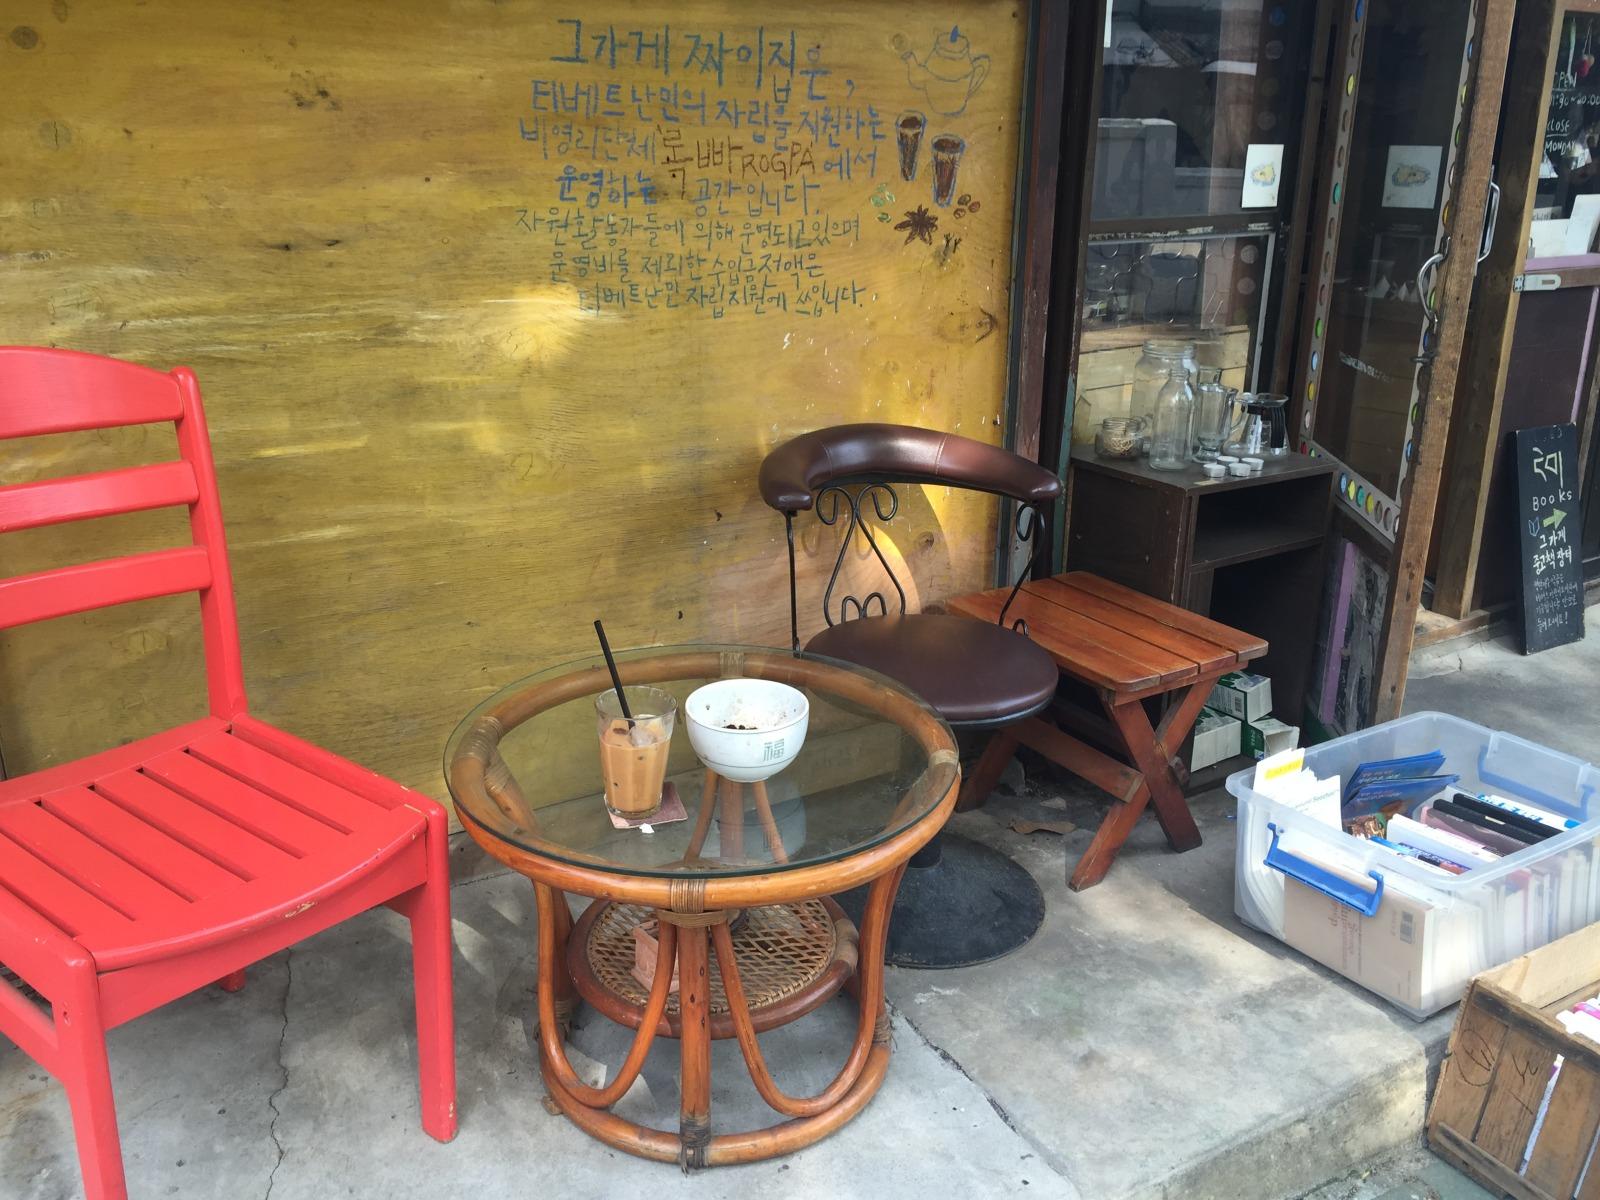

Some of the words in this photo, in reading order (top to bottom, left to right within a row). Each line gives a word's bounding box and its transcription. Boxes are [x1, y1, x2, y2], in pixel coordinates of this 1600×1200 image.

[1555, 71, 1578, 89] PEN
[715, 98, 792, 152] 자립을
[798, 104, 887, 149] 지원하는
[553, 164, 658, 208] 운영하는
[689, 175, 821, 218] 공간입니다.
[549, 247, 631, 284] 운영비를
[763, 738, 785, 761] 福
